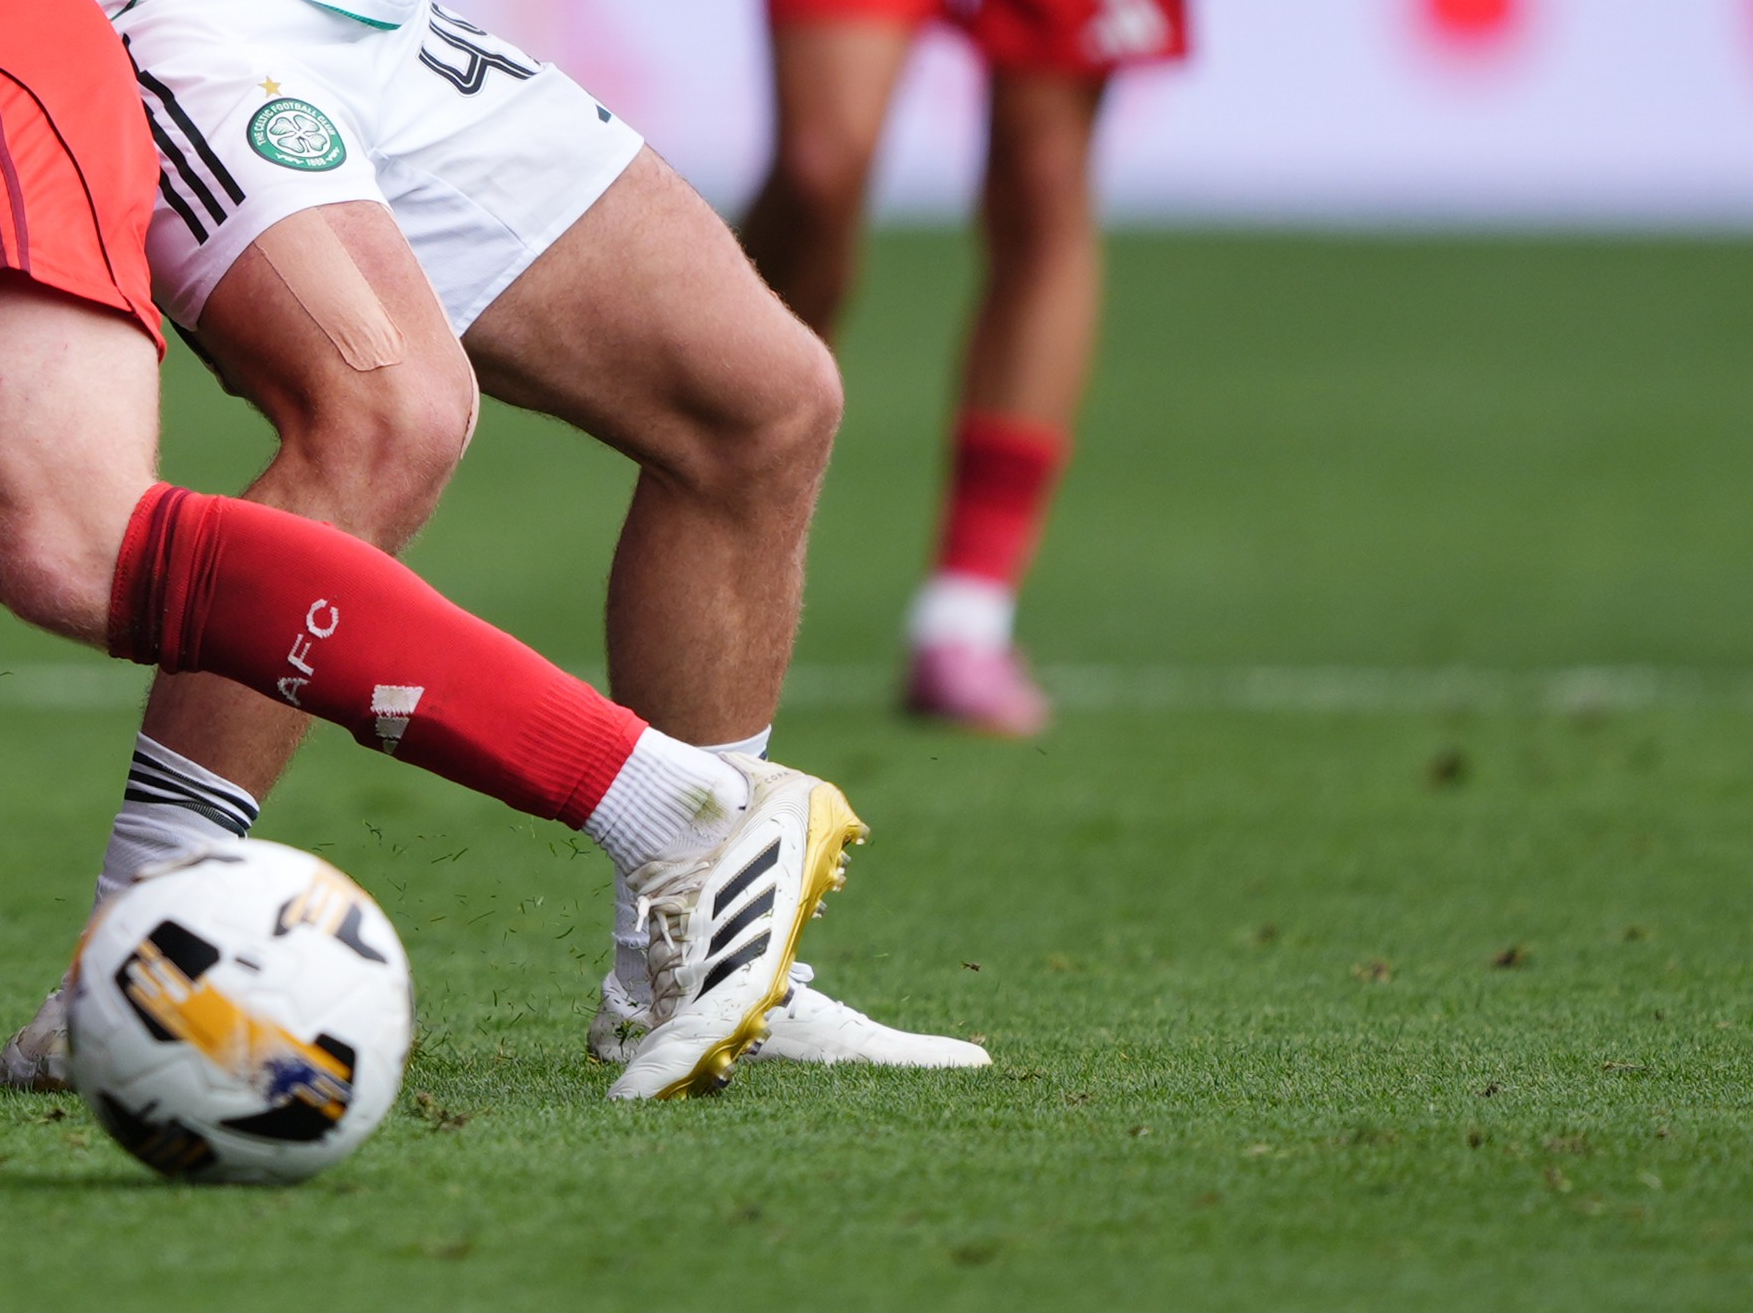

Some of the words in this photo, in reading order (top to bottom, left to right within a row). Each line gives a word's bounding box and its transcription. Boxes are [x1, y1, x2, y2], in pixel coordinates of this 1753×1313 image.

[271, 101, 318, 117] FOOTBALL
[253, 109, 274, 132] CELTIC
[317, 115, 336, 135] CLUB
[253, 131, 267, 146] THE
[277, 598, 339, 707] AFC
